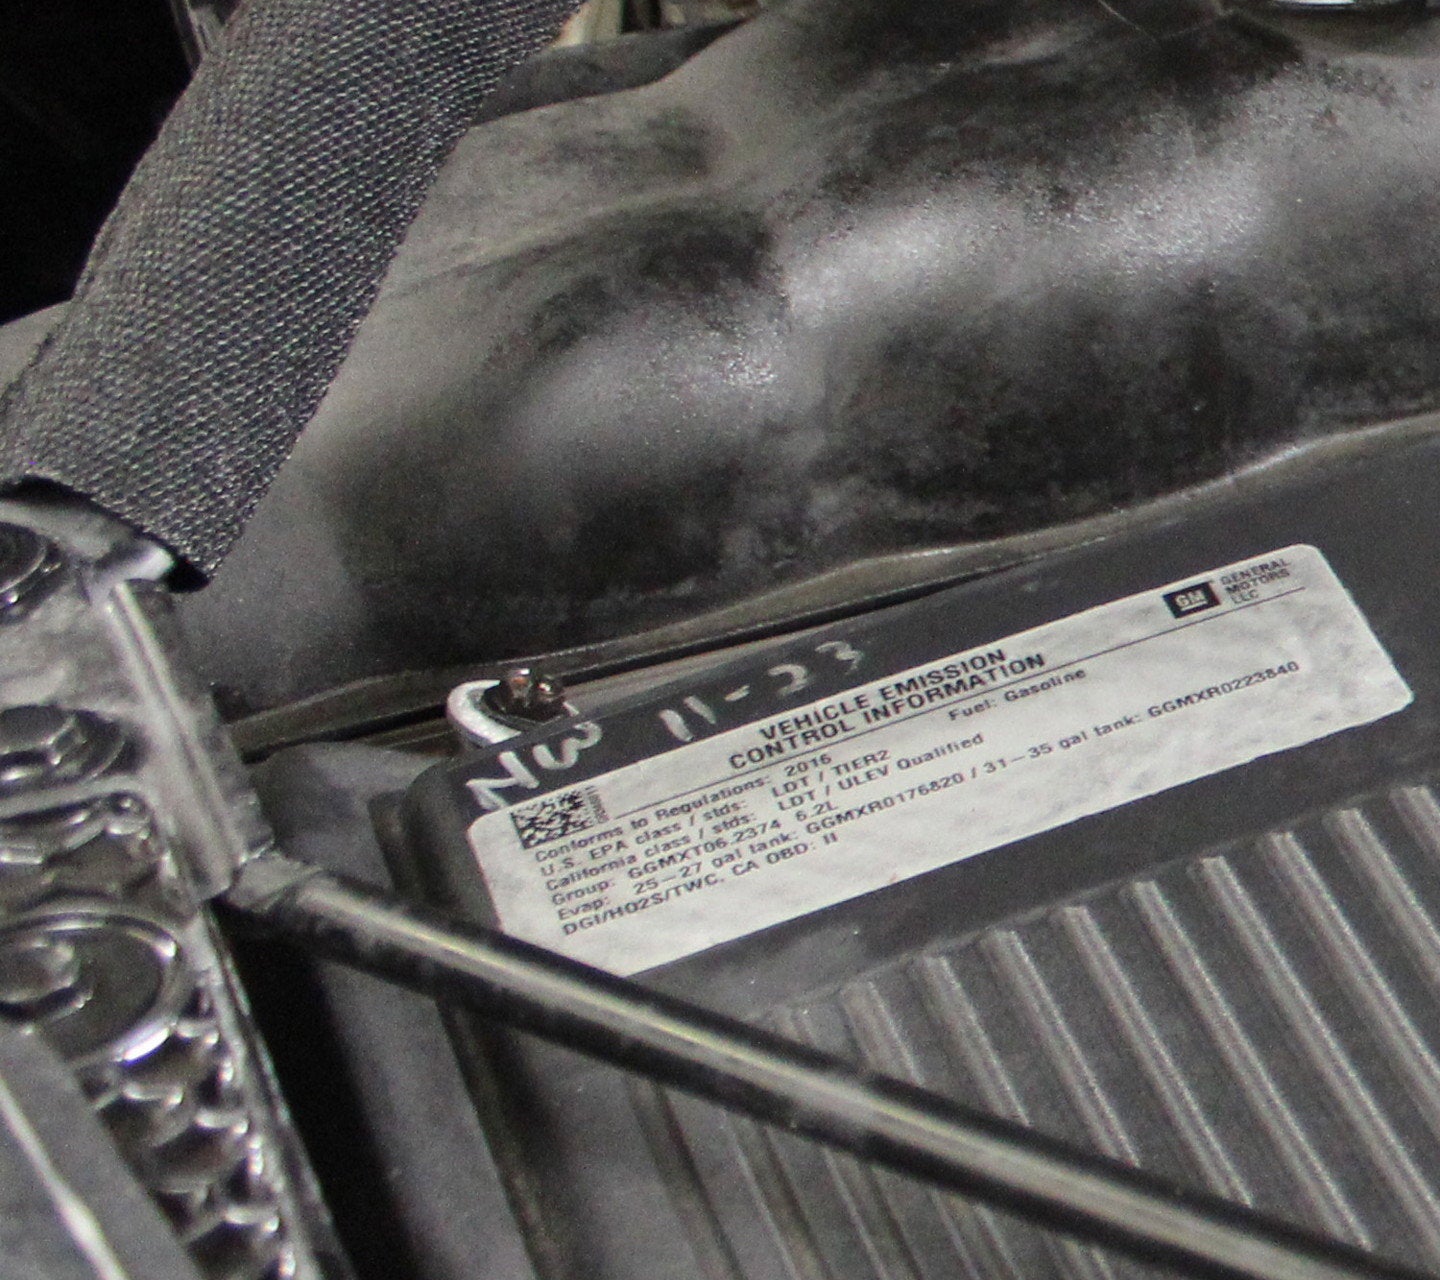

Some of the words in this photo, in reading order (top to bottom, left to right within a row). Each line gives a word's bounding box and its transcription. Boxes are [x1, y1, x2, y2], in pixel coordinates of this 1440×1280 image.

[1221, 558, 1291, 585] GENERAL
[1225, 569, 1290, 593] MOTORS
[729, 720, 856, 770] CONTROL
[863, 653, 1046, 724] INFORMATION
[760, 694, 871, 740] VEHICLE
[880, 648, 1007, 702] EMISSION
[948, 695, 997, 722] Fuel:
[1003, 667, 1087, 703] Gasoline
[535, 825, 624, 863] Conforms
[630, 817, 649, 831] to
[655, 775, 771, 821] Regulations:
[785, 753, 832, 777] 2016
[546, 853, 638, 891] California
[645, 834, 691, 858] class
[777, 790, 817, 811] LDT
[839, 766, 891, 791] ULEV
[896, 733, 985, 771] Qualified
[552, 879, 616, 907] Group:
[796, 799, 838, 822] 6.2L
[558, 896, 612, 922] Evap:
[711, 847, 743, 870] gal
[750, 831, 798, 855] tank:
[1058, 730, 1089, 751] gal
[1093, 712, 1142, 737] tank:
[590, 840, 628, 860] EPA
[635, 822, 682, 845] class
[771, 776, 810, 798] LDT
[833, 749, 891, 777] TIER2
[732, 860, 760, 877] CA
